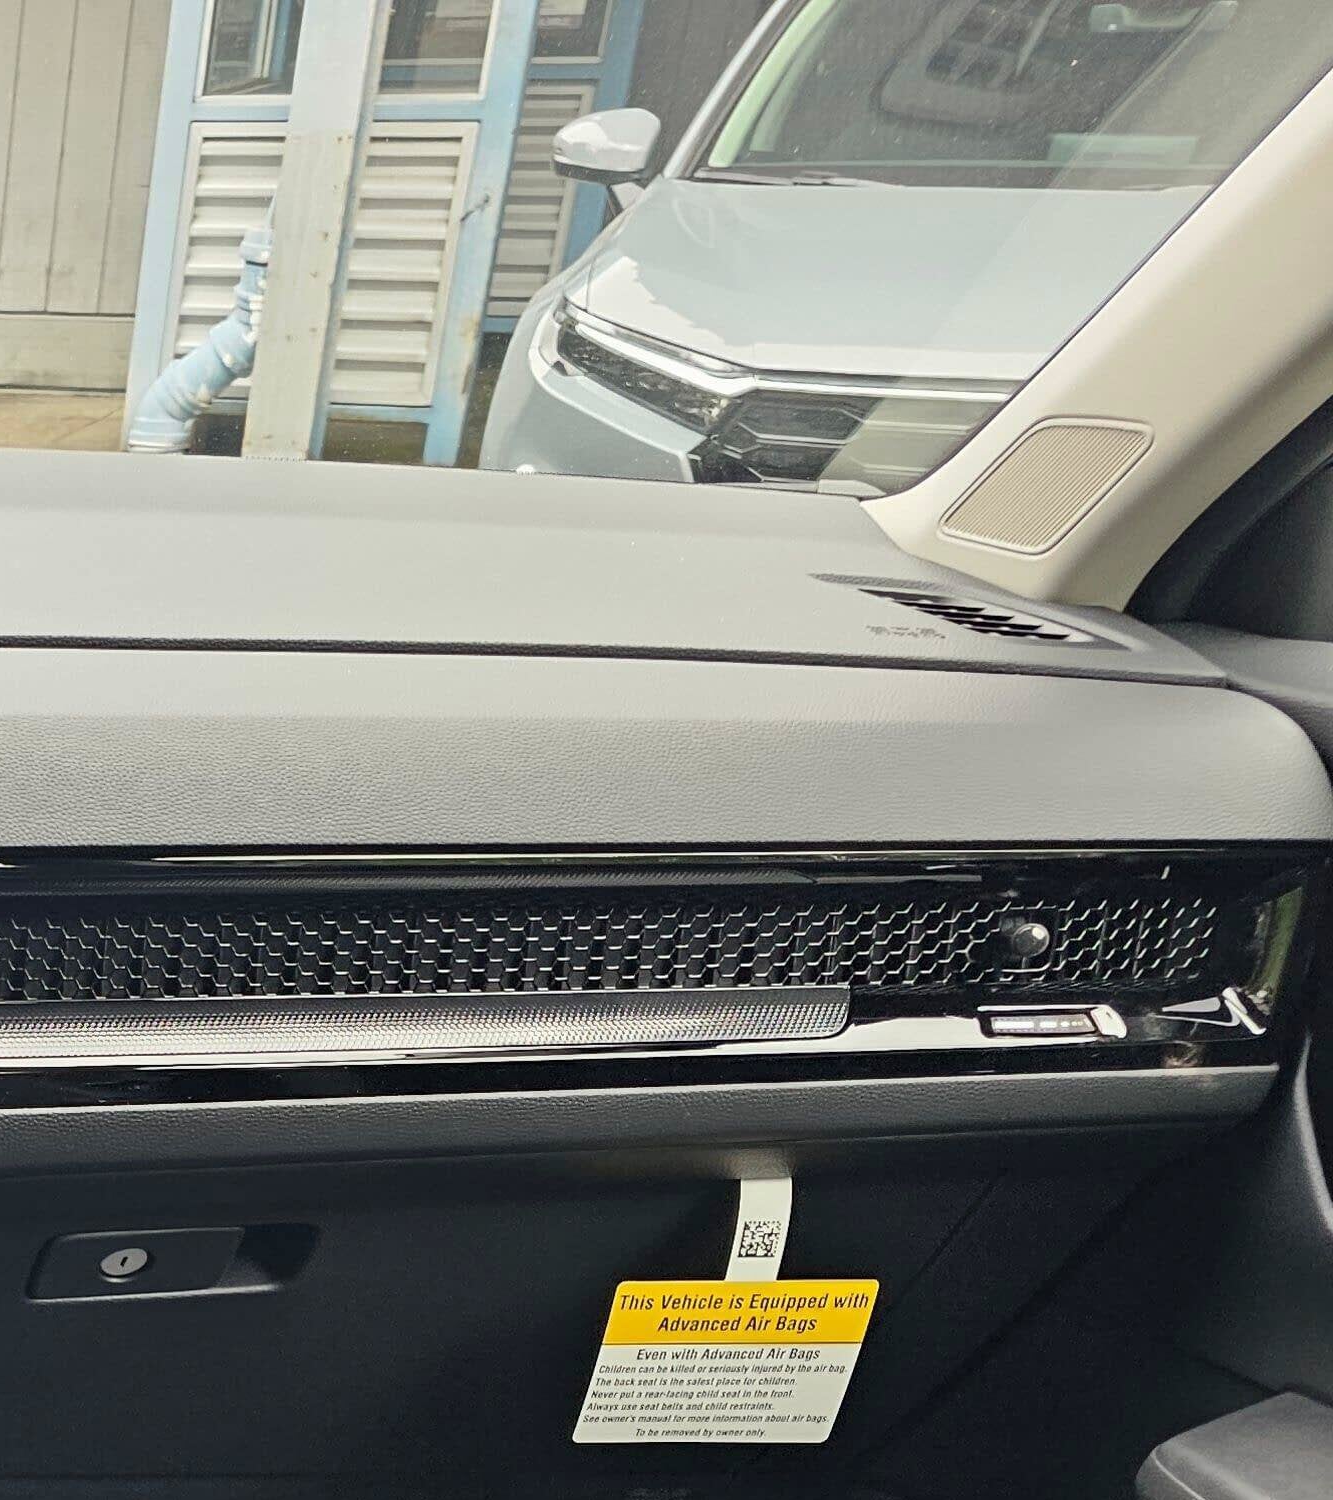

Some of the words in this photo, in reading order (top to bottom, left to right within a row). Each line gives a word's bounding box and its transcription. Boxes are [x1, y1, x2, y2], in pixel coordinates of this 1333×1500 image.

[619, 1294, 654, 1311] This
[660, 1294, 723, 1311] Vehicle
[728, 1294, 744, 1310] is
[748, 1293, 828, 1313] Equipped
[833, 1293, 870, 1308] with
[657, 1315, 741, 1332] Advanced
[745, 1315, 772, 1331] Air
[775, 1314, 818, 1334] Bags
[636, 1348, 667, 1361] Even
[671, 1348, 698, 1360] with
[701, 1348, 764, 1360] Advanced
[766, 1348, 786, 1360] Air
[788, 1348, 821, 1362] Bags
[598, 1364, 636, 1374] Children
[638, 1366, 654, 1374] can
[656, 1364, 668, 1374] be
[670, 1364, 695, 1374] killed
[708, 1364, 748, 1374] seriously
[751, 1364, 783, 1374] injured
[784, 1364, 796, 1374] by
[797, 1364, 812, 1373] the
[813, 1364, 827, 1373] air
[828, 1364, 848, 1374] bag.
[595, 1377, 612, 1387] The
[614, 1377, 635, 1387] back
[637, 1377, 657, 1387] seat
[659, 1377, 668, 1387] is
[669, 1377, 684, 1387] the
[686, 1377, 714, 1387] safest
[716, 1377, 741, 1387] place
[743, 1377, 756, 1387] for
[758, 1377, 798, 1387] children.
[591, 1390, 618, 1400] Never
[619, 1390, 635, 1400] put
[644, 1390, 694, 1400] rear-facing
[696, 1390, 719, 1400] child
[721, 1390, 741, 1400] seat
[742, 1390, 752, 1400] in
[754, 1390, 768, 1400] the
[770, 1390, 794, 1400] front.
[586, 1402, 619, 1412] Always
[639, 1402, 660, 1411] seat
[661, 1402, 683, 1411] belts
[685, 1402, 703, 1411] and
[705, 1402, 727, 1411] child
[729, 1402, 774, 1411] restraints.
[583, 1415, 600, 1423] See
[602, 1415, 636, 1423] owner's
[638, 1415, 672, 1423] manual
[673, 1414, 685, 1423] for
[687, 1415, 710, 1423] more
[712, 1414, 763, 1423] information
[765, 1414, 790, 1423] about
[792, 1414, 805, 1423] air
[806, 1414, 829, 1423] bags.
[636, 1428, 646, 1438] To
[647, 1428, 659, 1438] be
[661, 1428, 700, 1438] removed
[702, 1428, 713, 1438] by
[745, 1428, 766, 1438] only.
